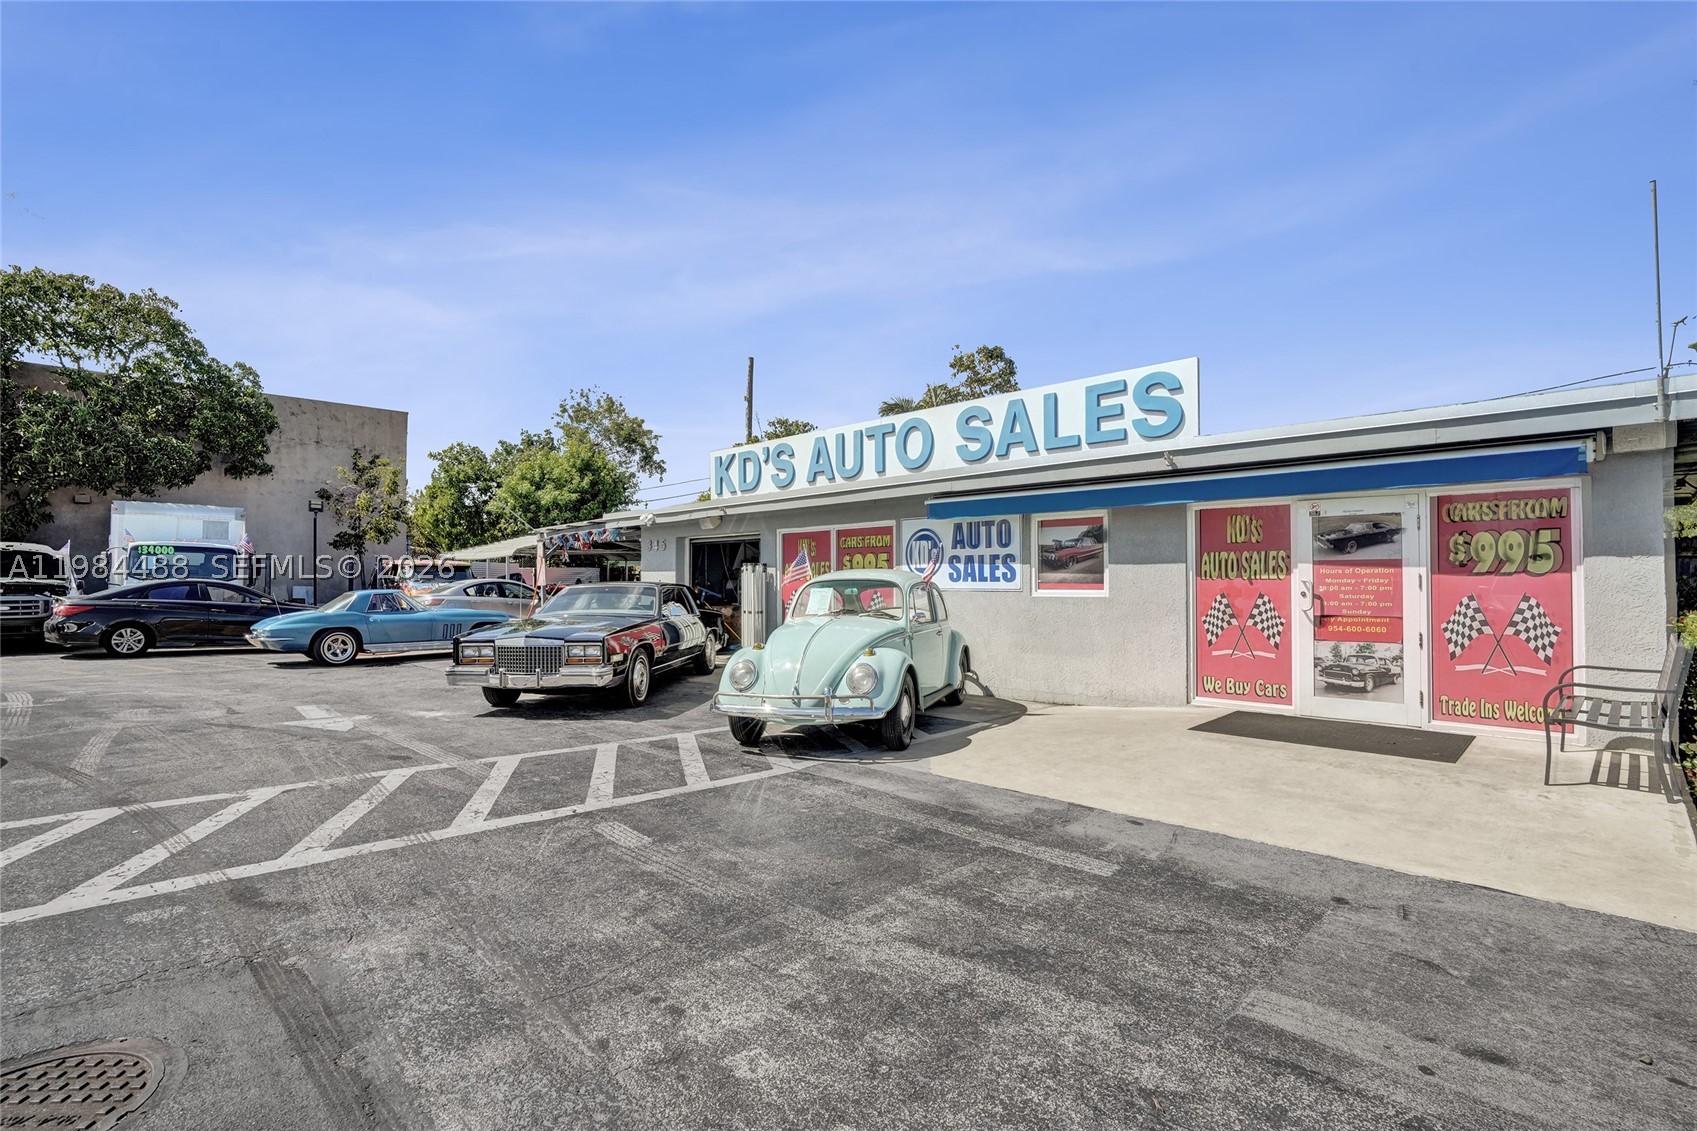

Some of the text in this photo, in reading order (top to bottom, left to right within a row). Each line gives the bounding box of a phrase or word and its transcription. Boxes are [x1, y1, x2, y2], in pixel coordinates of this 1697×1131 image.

[714, 371, 1186, 496] KD'S AUTO SALES
[840, 534, 891, 549] CARS FROM
[950, 519, 1012, 550] AUTO
[137, 545, 175, 555] $34000
[1449, 528, 1564, 577] $995
[948, 553, 1016, 583] SALES
[1201, 550, 1288, 580] AUTO SALES
[1355, 567, 1395, 575] Operation
[1202, 675, 1288, 699] We Buy Cars
[1439, 694, 1477, 717] Trade
[1480, 698, 1500, 720] Ins
